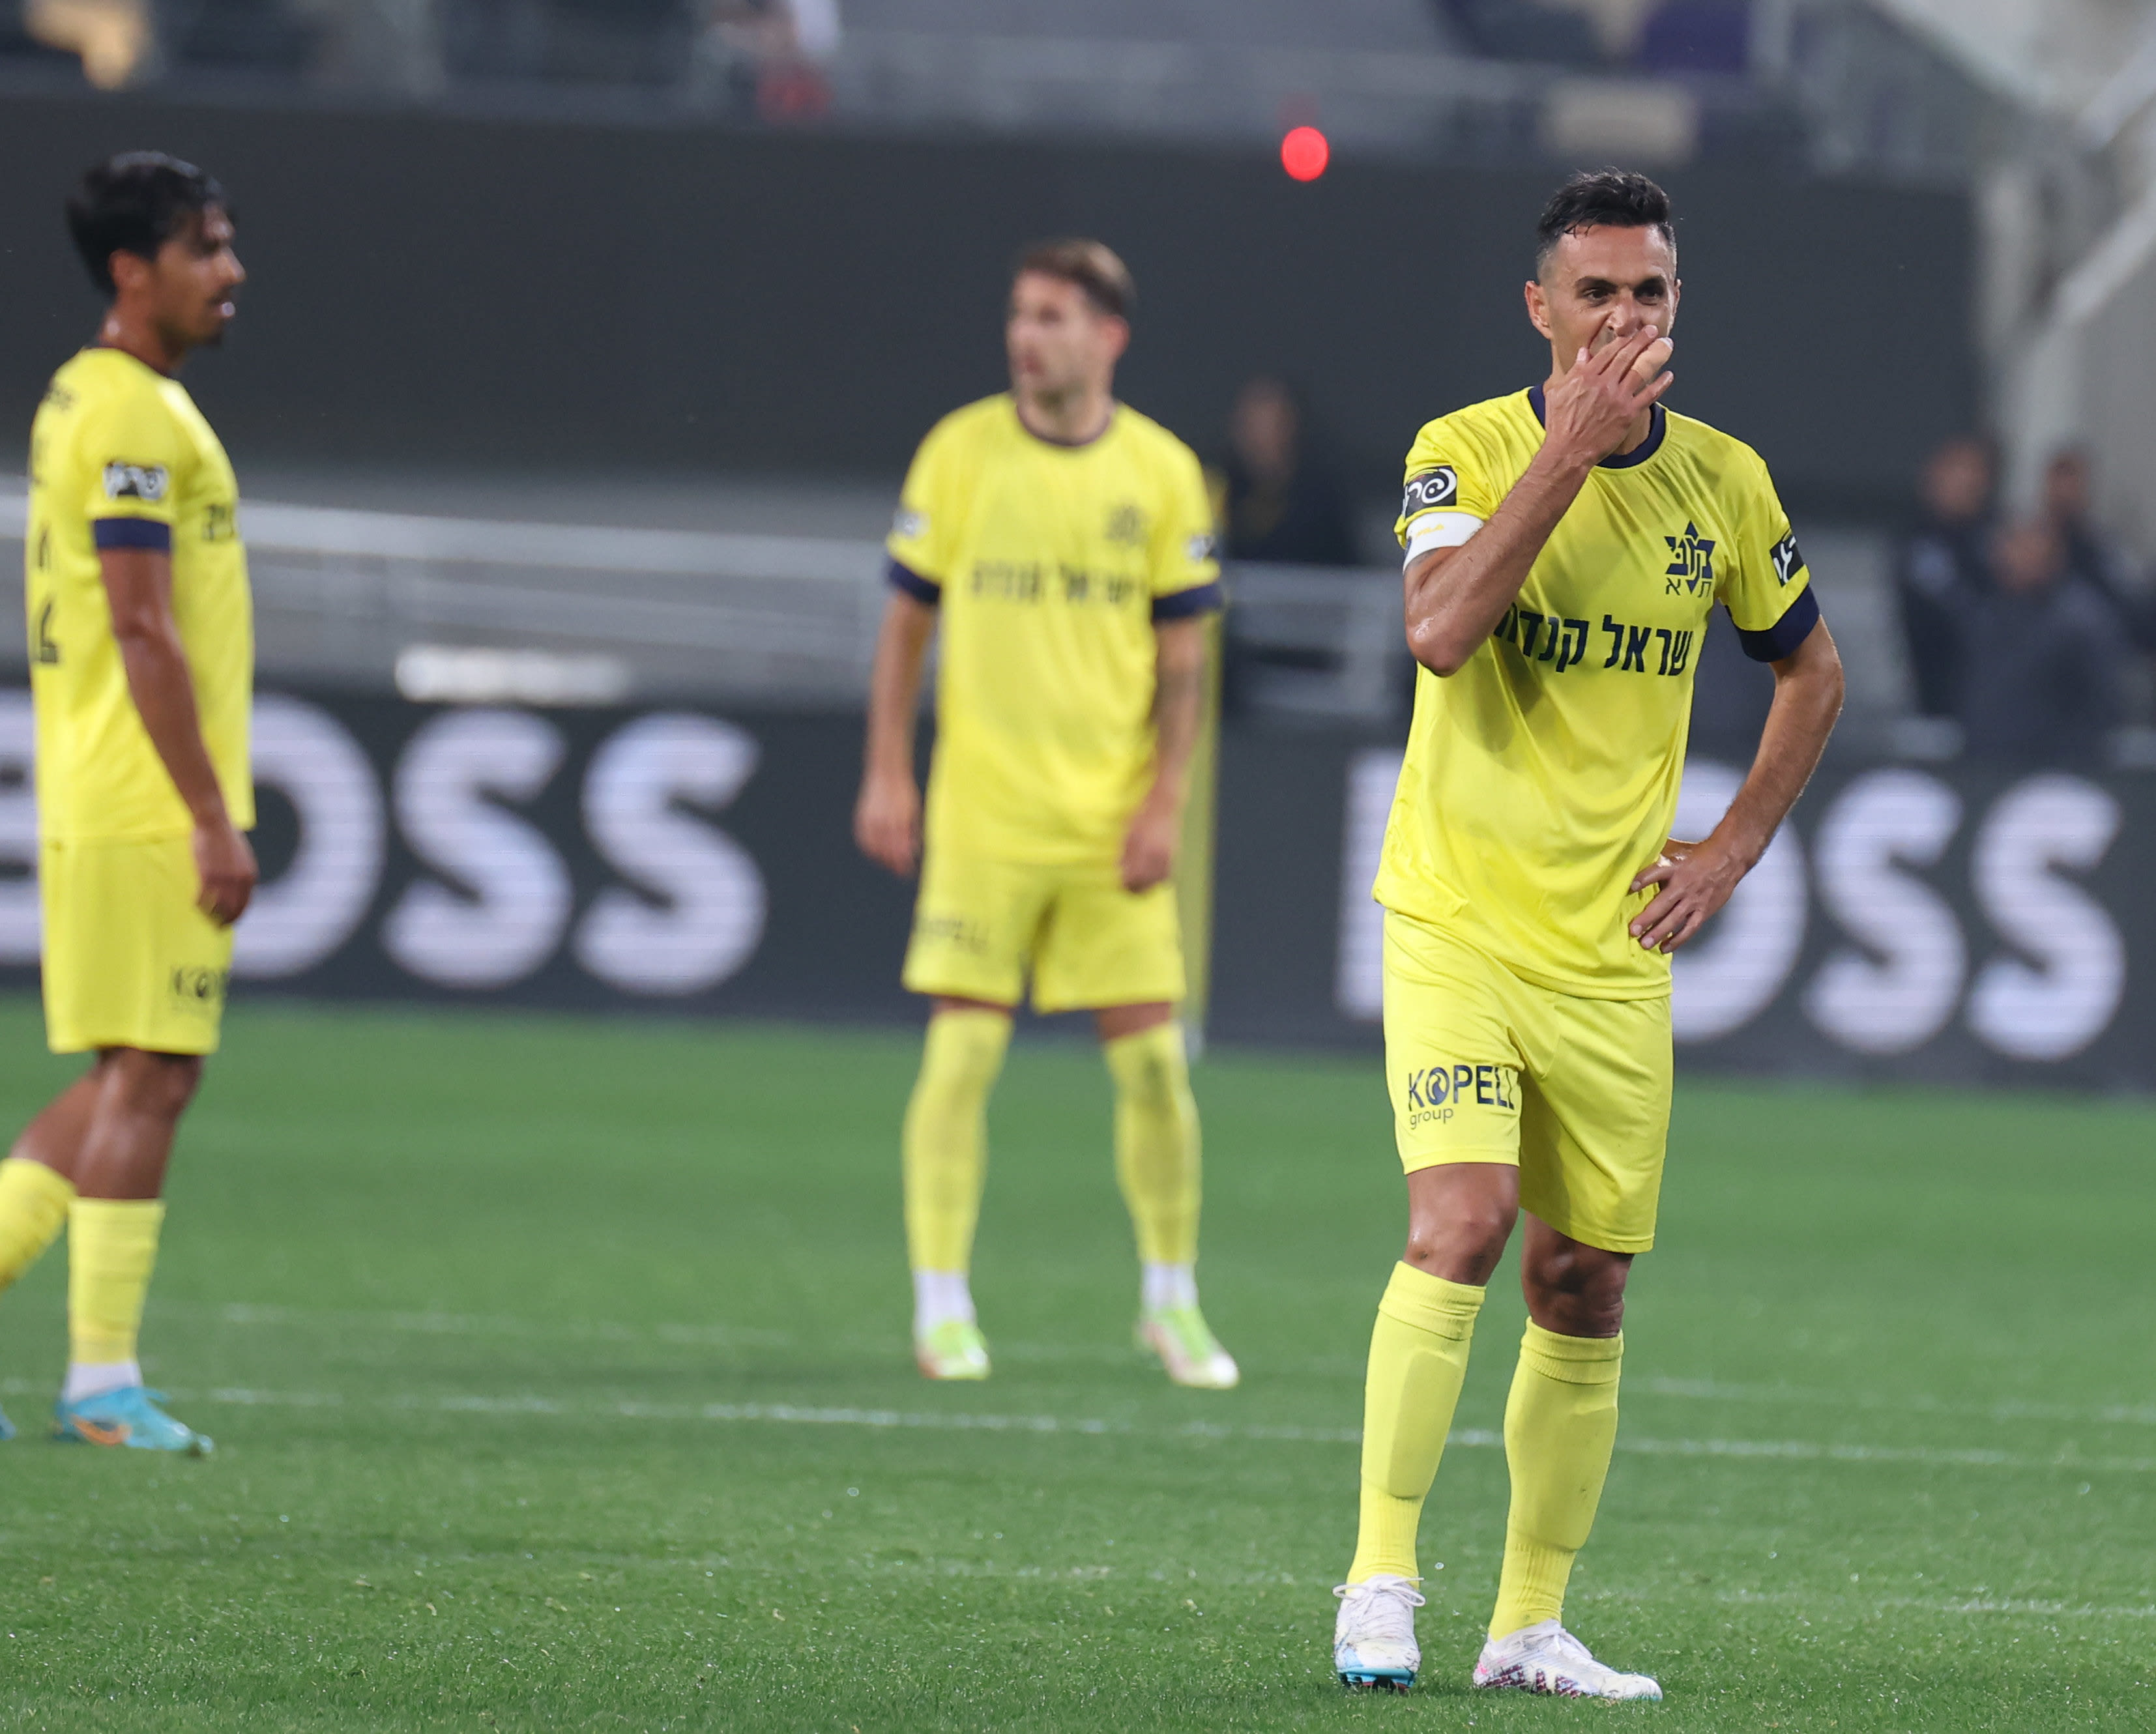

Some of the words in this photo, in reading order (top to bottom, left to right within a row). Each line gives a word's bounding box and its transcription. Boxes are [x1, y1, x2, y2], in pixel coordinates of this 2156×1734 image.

[1602, 614, 1694, 676] שראל
[0, 687, 769, 997] OSS
[1333, 746, 2127, 1062] OSS
[1409, 1108, 1454, 1131] group
